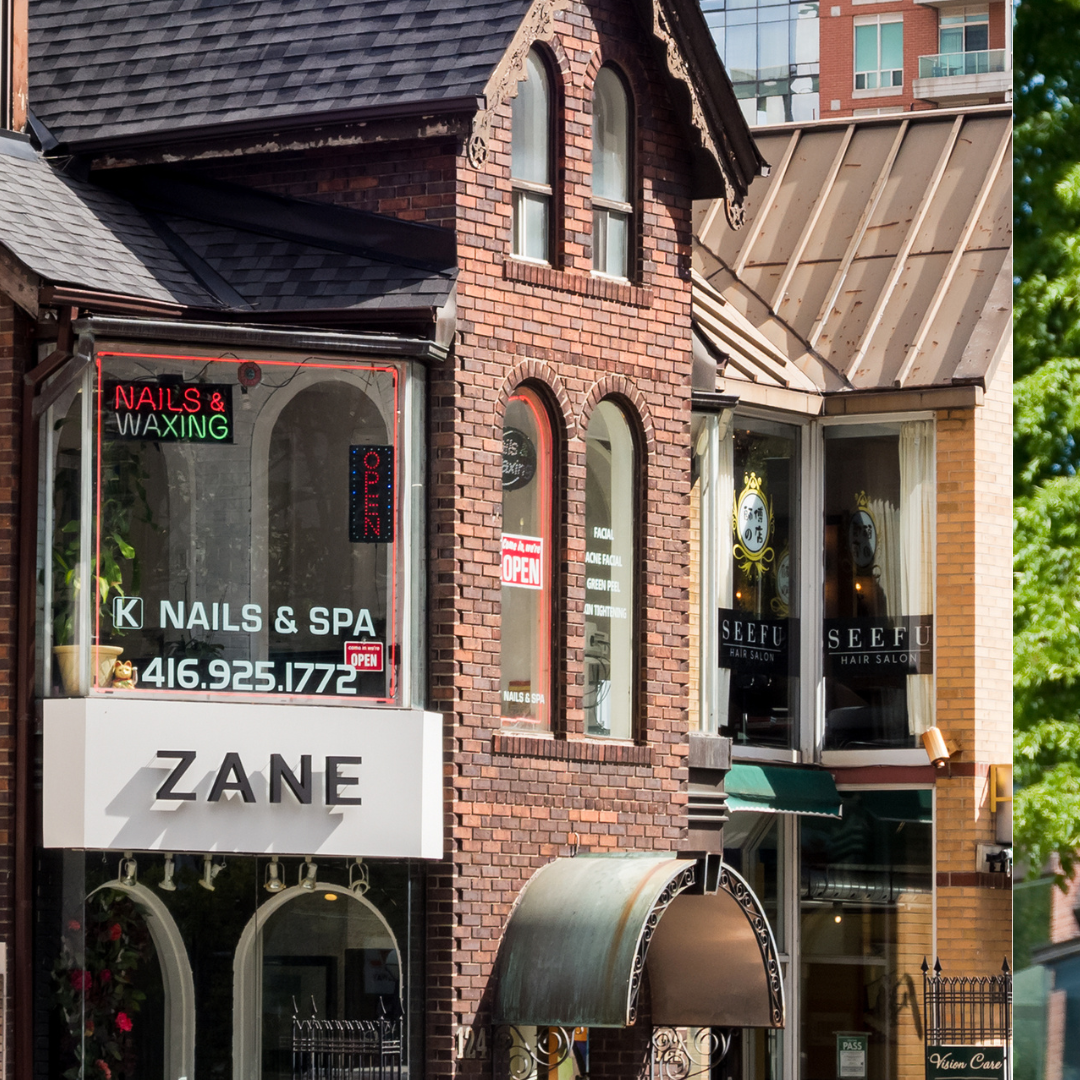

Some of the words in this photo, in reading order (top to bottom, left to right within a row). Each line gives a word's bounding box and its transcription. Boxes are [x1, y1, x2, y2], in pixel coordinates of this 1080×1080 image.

[115, 385, 201, 413] NAILS
[210, 392, 225, 413] &
[115, 412, 229, 439] WAXING
[363, 451, 380, 536] OPEN
[593, 526, 615, 541] FACIAL
[502, 538, 518, 551] Come
[585, 551, 602, 565] ACNE
[602, 553, 623, 568] FACIAL
[503, 554, 540, 585] OPEN
[586, 577, 607, 592] GREEN
[607, 580, 621, 593] PEEL
[115, 599, 139, 628] K
[160, 600, 262, 633] NAILS
[274, 606, 299, 634] &
[309, 606, 376, 637] SPA
[593, 605, 628, 620] TIGHTENING
[722, 619, 783, 647] SEEFU
[828, 625, 931, 649] SEEFU
[350, 653, 378, 667] OPEN
[729, 647, 747, 658] HAIR
[750, 650, 775, 662] SALON
[841, 655, 870, 665] HAIR
[875, 653, 917, 664] SALON
[141, 656, 357, 695] 416.925.1772
[503, 690, 524, 703] NAILS
[524, 692, 531, 704] &
[531, 693, 546, 705] SPA
[155, 750, 363, 807] ZANE
[455, 1026, 488, 1059] 124
[842, 1041, 863, 1051] PASS
[929, 1052, 968, 1070] Vision
[969, 1052, 1003, 1070] Care
